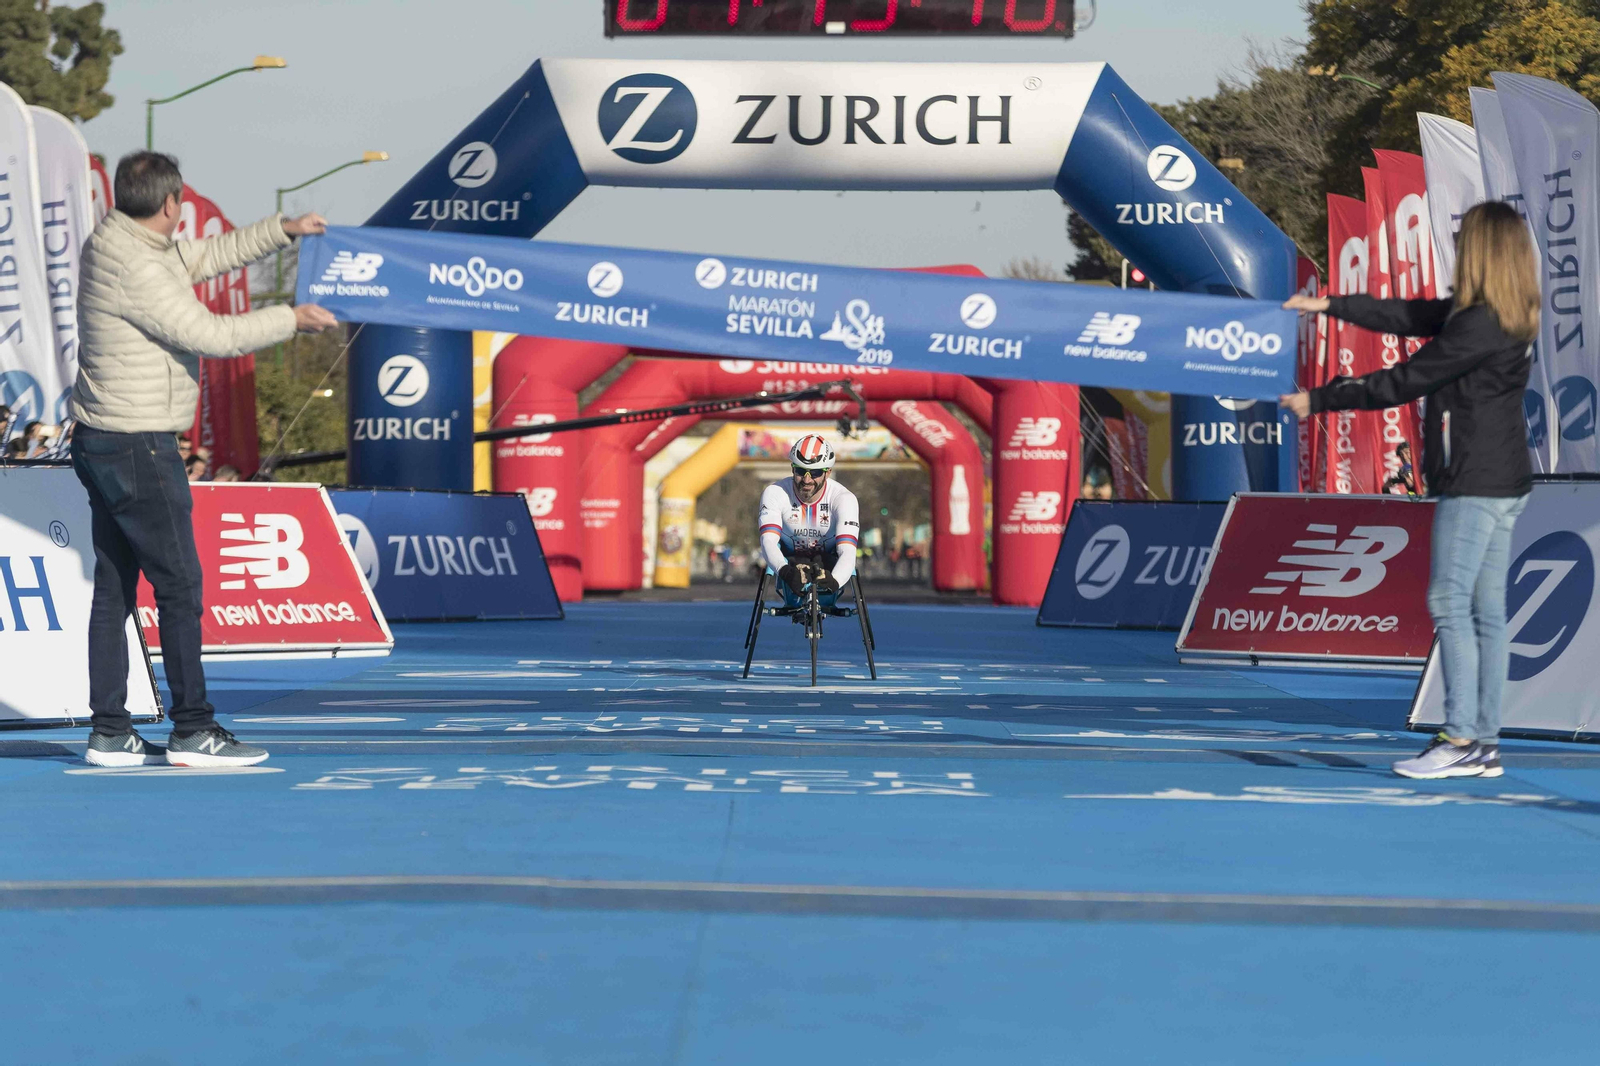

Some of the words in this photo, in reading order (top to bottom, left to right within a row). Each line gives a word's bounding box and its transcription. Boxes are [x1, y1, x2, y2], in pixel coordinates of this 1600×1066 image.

[731, 94, 1013, 146] ZURICH
[410, 199, 520, 222] ZURICH
[1115, 202, 1225, 226] ZURICH
[309, 282, 335, 296] new
[336, 282, 390, 298] balance
[729, 266, 819, 293] ZURICH
[554, 301, 649, 328] ZURICH
[728, 293, 816, 319] MARATÓN
[725, 313, 814, 340] SEVILLA
[856, 347, 894, 366] 2019
[927, 332, 1024, 360] ZURICH
[1063, 343, 1090, 358] new
[1092, 343, 1148, 363] balance
[353, 416, 451, 441] ZURICH
[1182, 421, 1283, 447] ZURICH
[516, 445, 565, 457] balance
[1022, 448, 1068, 461] balance
[533, 519, 565, 531] ance
[794, 528, 822, 538] MADERA
[387, 534, 519, 577] ZURICH
[210, 600, 259, 627] new
[259, 598, 356, 626] balance
[1212, 606, 1274, 632] new
[1275, 604, 1399, 633] balance
[322, 765, 975, 780] ZURICH
